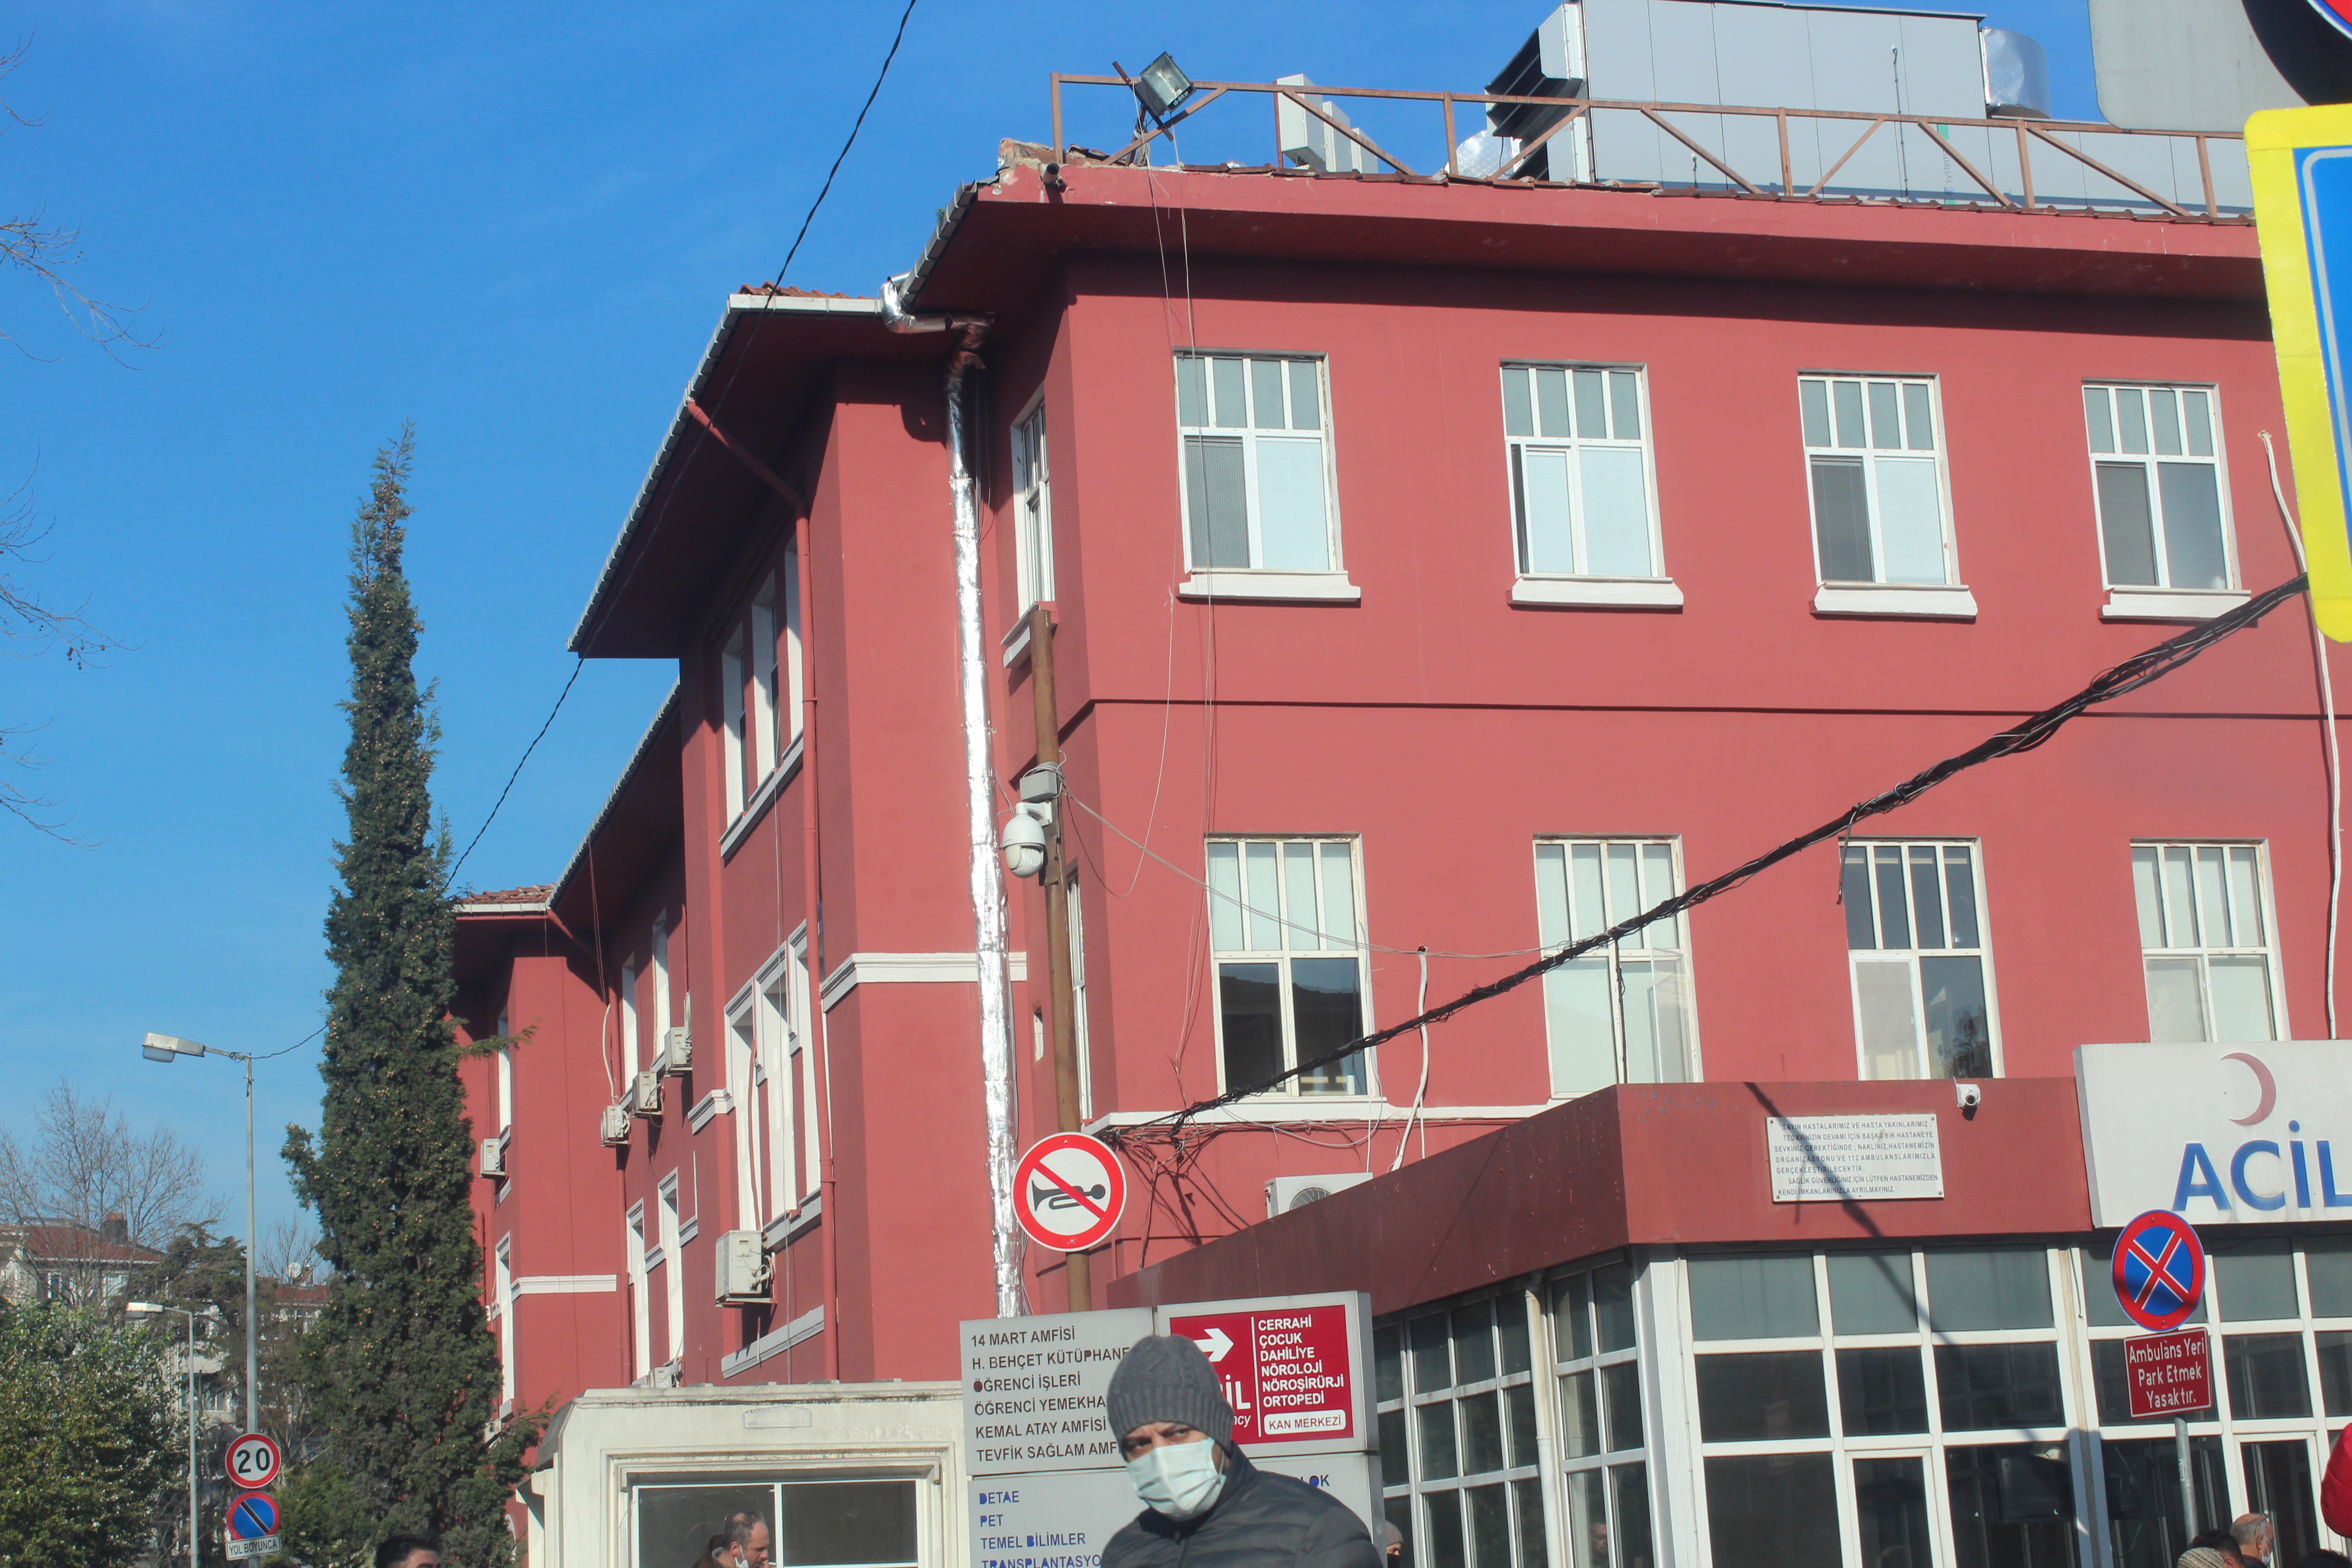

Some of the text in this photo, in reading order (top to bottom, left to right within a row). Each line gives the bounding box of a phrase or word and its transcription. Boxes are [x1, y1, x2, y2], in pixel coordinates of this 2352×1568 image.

[1783, 1133, 1821, 1141] TEDAVİNİZİN
[1848, 1132, 1860, 1141] İÇİN
[1885, 1131, 1895, 1139] BİR
[1774, 1144, 1803, 1152] SEVKİNİZ
[1805, 1143, 1852, 1152] GEREKTİĞİNDE
[1775, 1154, 1835, 1163] ORGANİZASYONU
[1861, 1153, 1936, 1161] AMBULANSLARIMIZLA
[2171, 1120, 2352, 1211] ACİL
[1788, 1173, 1938, 1185] SAĞLIK GÜVENLİĞİNİZ İÇİN LÜTFEN HASTANEMİZDEN
[1798, 1187, 1850, 1195] İMKANLARINIZLA
[1258, 1314, 1312, 1331] CERRAHİ
[971, 1325, 1075, 1347] 14 MART AMFİSİ
[1259, 1332, 1303, 1349] ÇOCUK
[1260, 1345, 1315, 1362] DAHİLİYE
[2129, 1337, 2205, 1364] Ambulans Yeri
[972, 1358, 985, 1370] H.
[990, 1353, 1043, 1370] BEHÇET
[1261, 1359, 1323, 1377] NÖROLOJİ
[973, 1371, 1081, 1392] ÖĞRENCİ İŞLERİ
[1262, 1373, 1344, 1392] NÖROŞİRÜRJİ
[2138, 1361, 2202, 1387] Park Etmek
[1220, 1374, 1251, 1410] İL
[1263, 1390, 1325, 1408] ORTOPEDİ
[974, 1395, 1106, 1416] ÖĞRENCİ YEMEKHA
[975, 1416, 1107, 1439] KEMAL ATAY AMFİSİ
[1269, 1414, 1341, 1431] KAN MERKEZİ
[977, 1441, 1121, 1462] TEVFİK SAĞLAM AMF
[237, 1448, 270, 1474] 20
[979, 1490, 1020, 1504] DETAE
[980, 1514, 1004, 1527] PET
[229, 1539, 278, 1555] YOL BOYUNCA
[980, 1532, 1086, 1549] TEMEL BİLİMLER
[981, 1554, 1102, 1568] TRANSPLANTASYO
